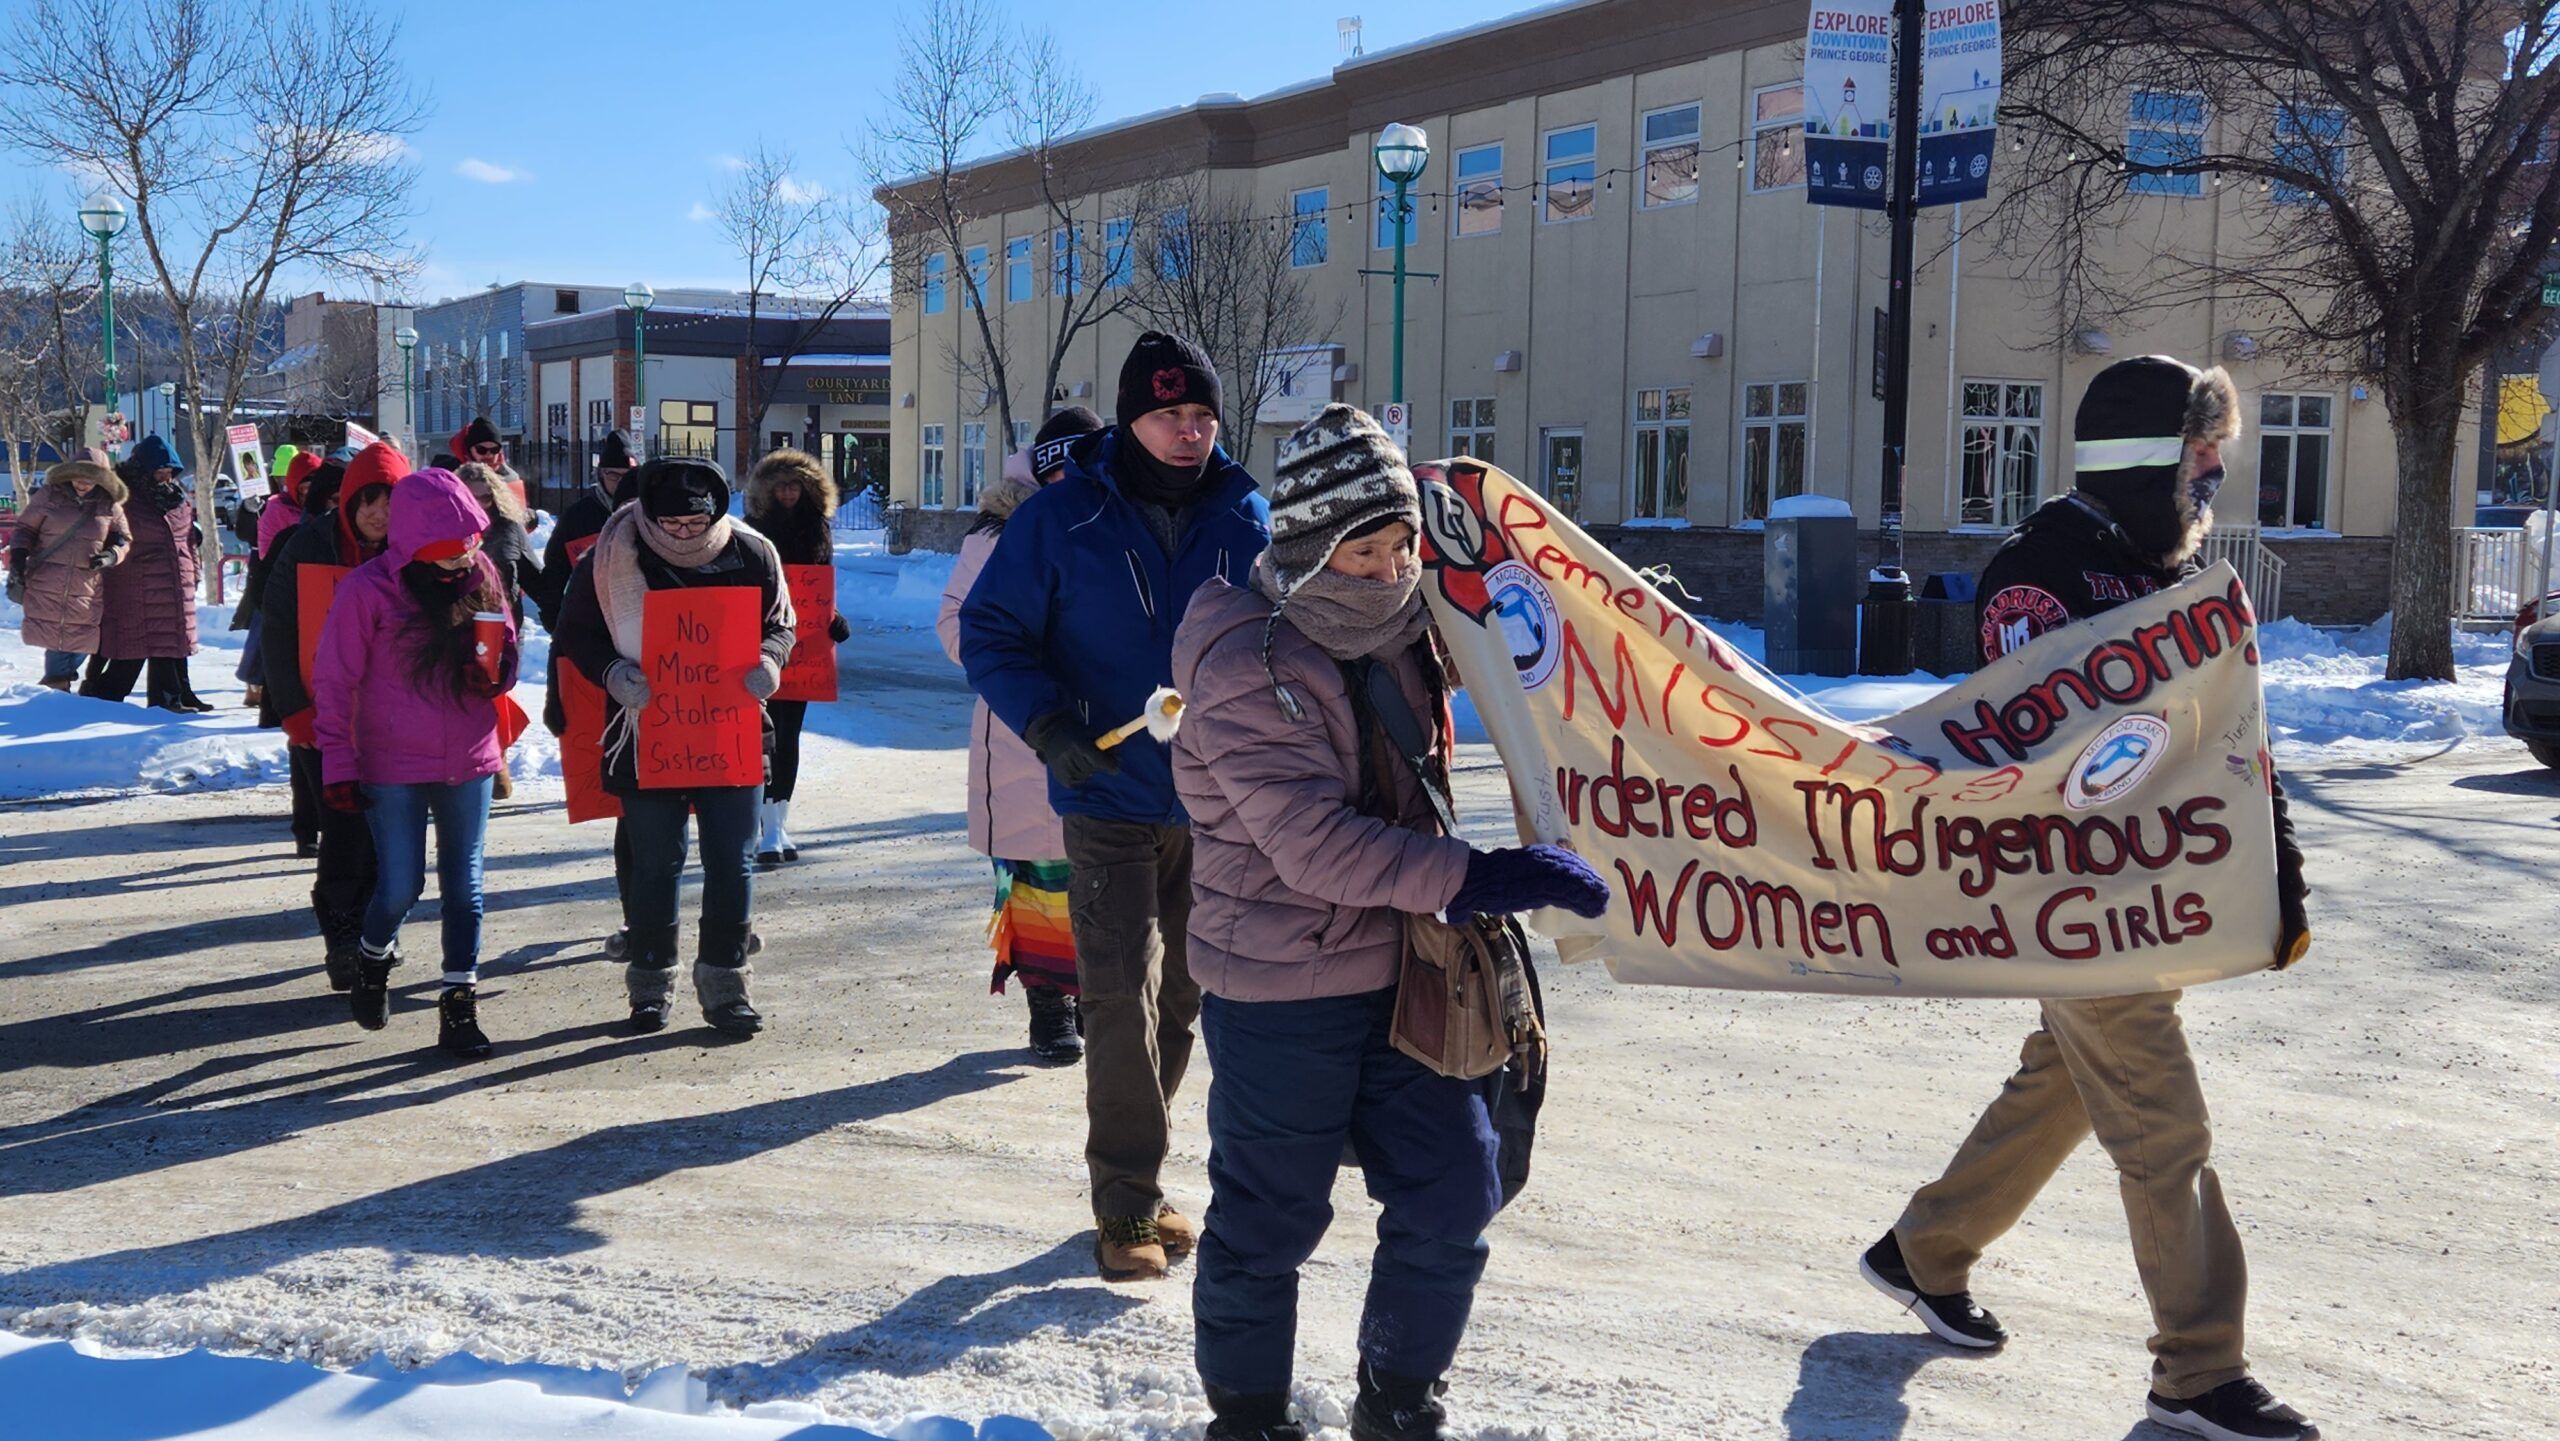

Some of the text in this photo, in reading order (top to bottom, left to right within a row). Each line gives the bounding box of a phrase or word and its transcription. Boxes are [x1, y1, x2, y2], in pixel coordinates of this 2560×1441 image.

[1814, 11, 1888, 35] EXPLORE
[1929, 1, 1995, 30] EXPLORE
[1812, 31, 1888, 50] DOWNTOWN
[1928, 22, 1996, 46] DOWNTOWN
[1810, 48, 1888, 64] PRINCE GEORGE
[1928, 38, 1997, 58] PRINCE GEORGE
[806, 377, 890, 389] COURTYARD
[829, 392, 864, 403] LANE
[1532, 583, 1554, 616] LAKE
[676, 610, 710, 645] No
[657, 650, 721, 686] More
[652, 692, 742, 727] Stolen
[2136, 722, 2163, 738] LAKE
[1926, 903, 2019, 960] and
